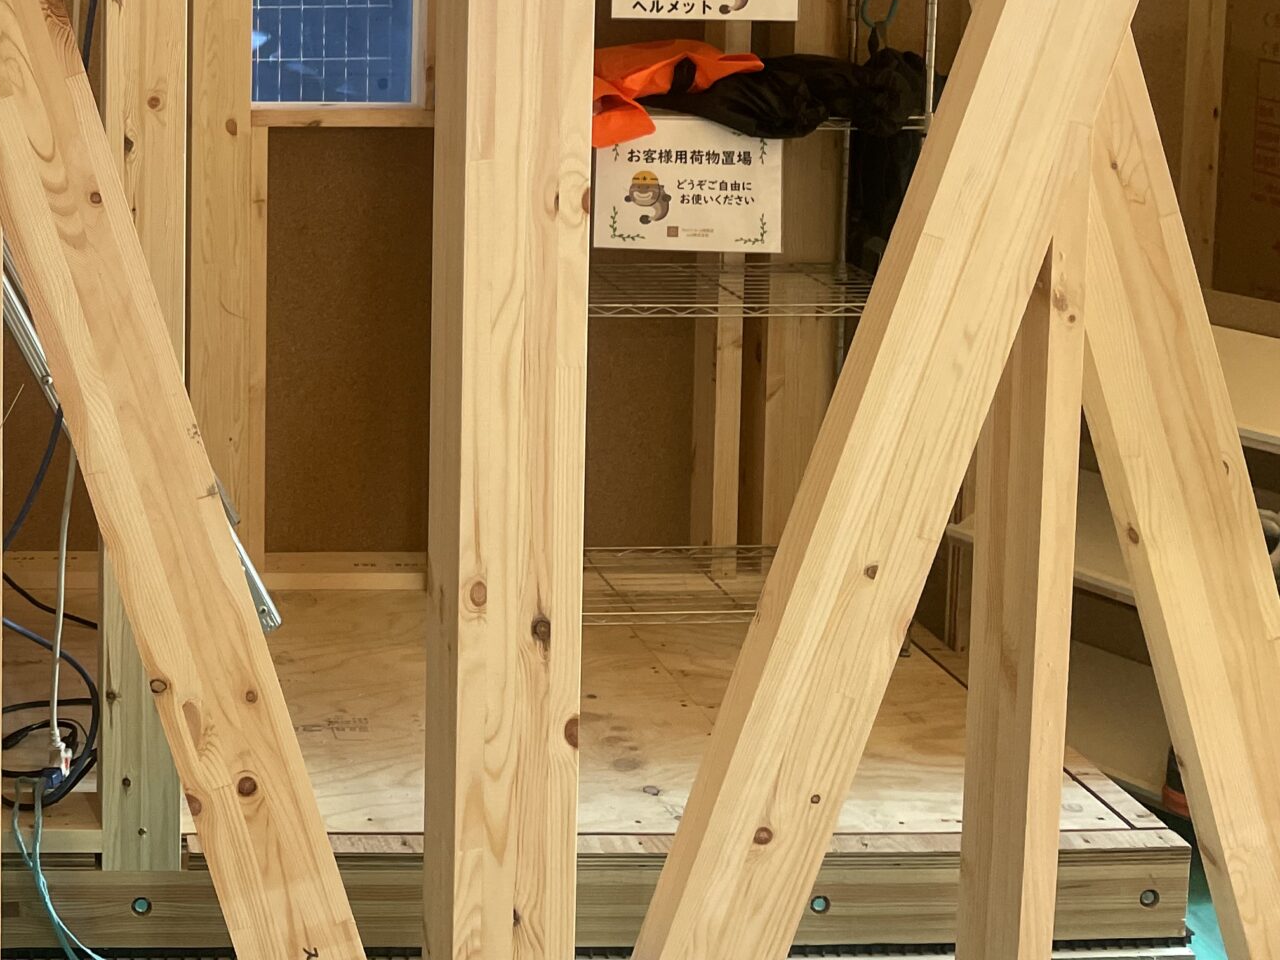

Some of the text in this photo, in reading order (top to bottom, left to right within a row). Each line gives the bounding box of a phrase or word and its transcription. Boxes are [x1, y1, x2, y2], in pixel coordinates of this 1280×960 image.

[632, 0, 713, 16] ヘルメット
[626, 149, 753, 166] お客様用荷物置場
[676, 179, 753, 192] どうぞご自由に
[680, 194, 755, 206] お使いください
